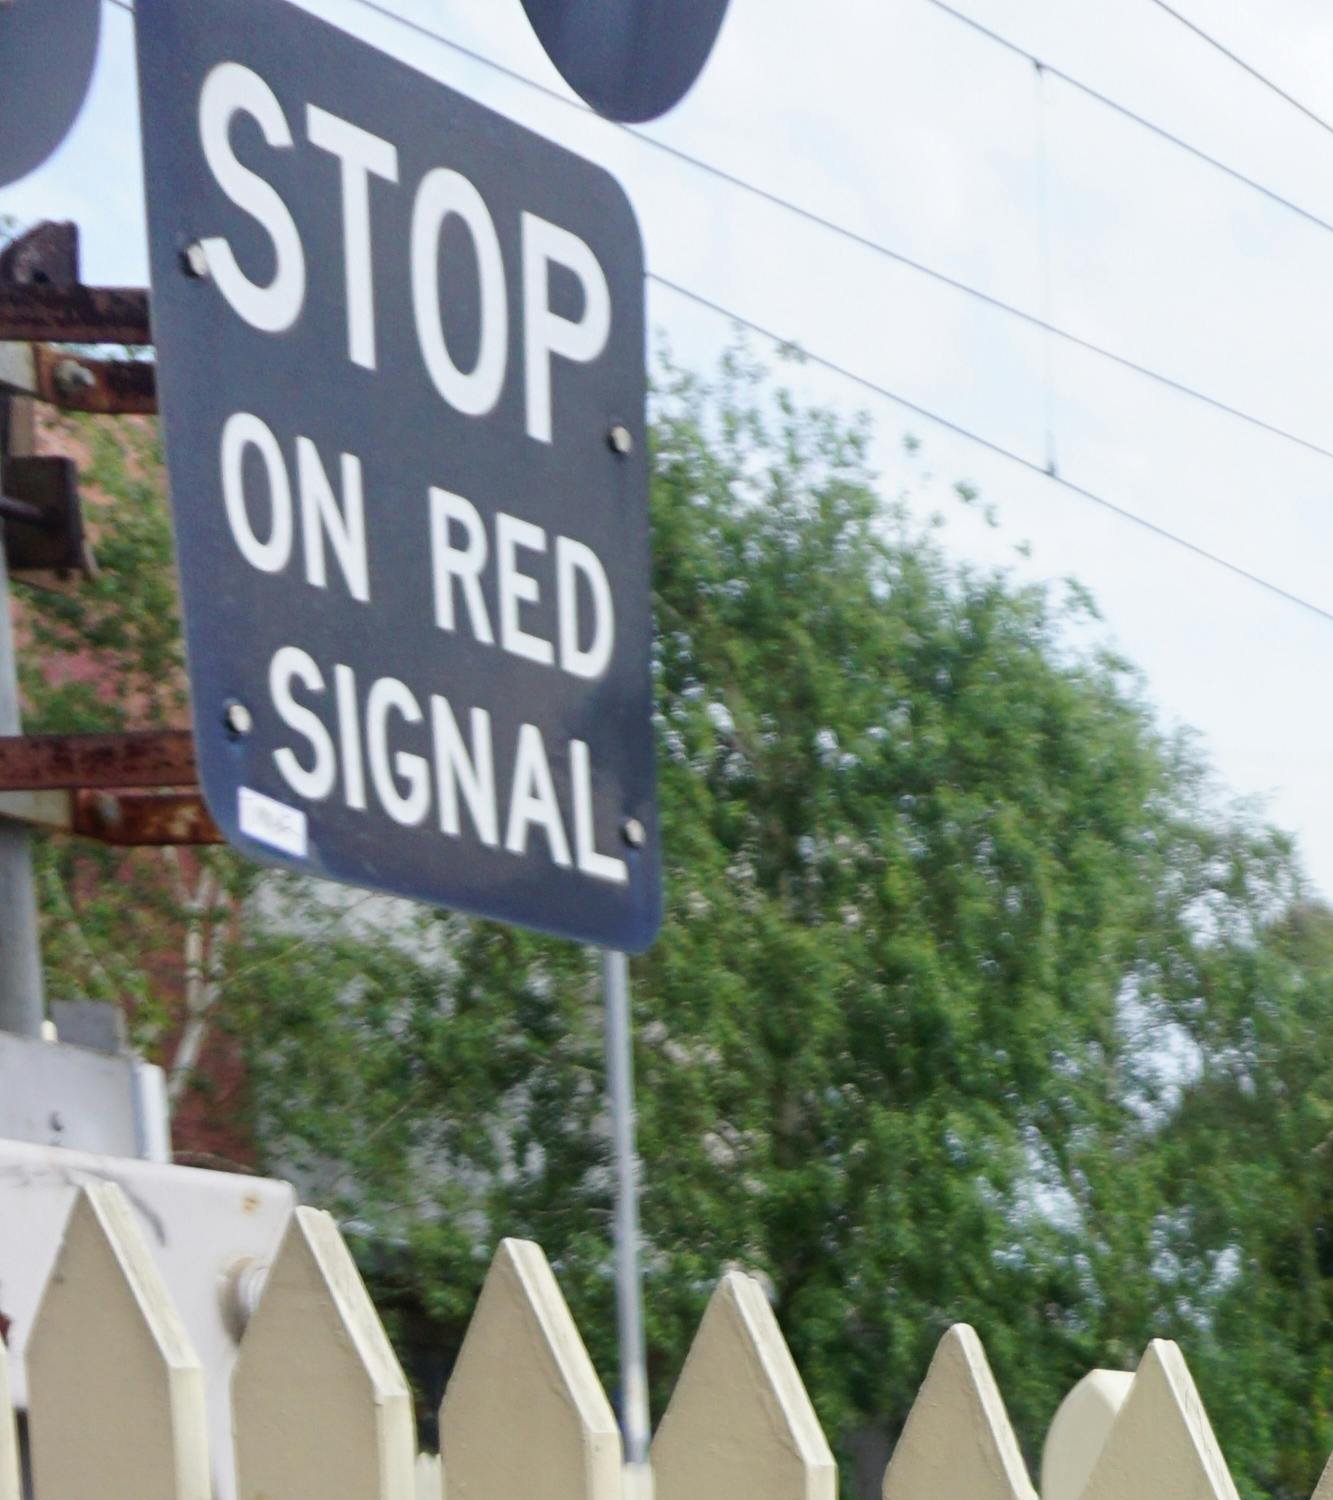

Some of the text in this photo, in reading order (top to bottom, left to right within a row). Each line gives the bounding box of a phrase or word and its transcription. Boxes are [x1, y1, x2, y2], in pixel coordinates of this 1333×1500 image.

[199, 62, 612, 445] STOP
[220, 411, 617, 681] ON RED
[269, 645, 629, 884] SIGNAL
